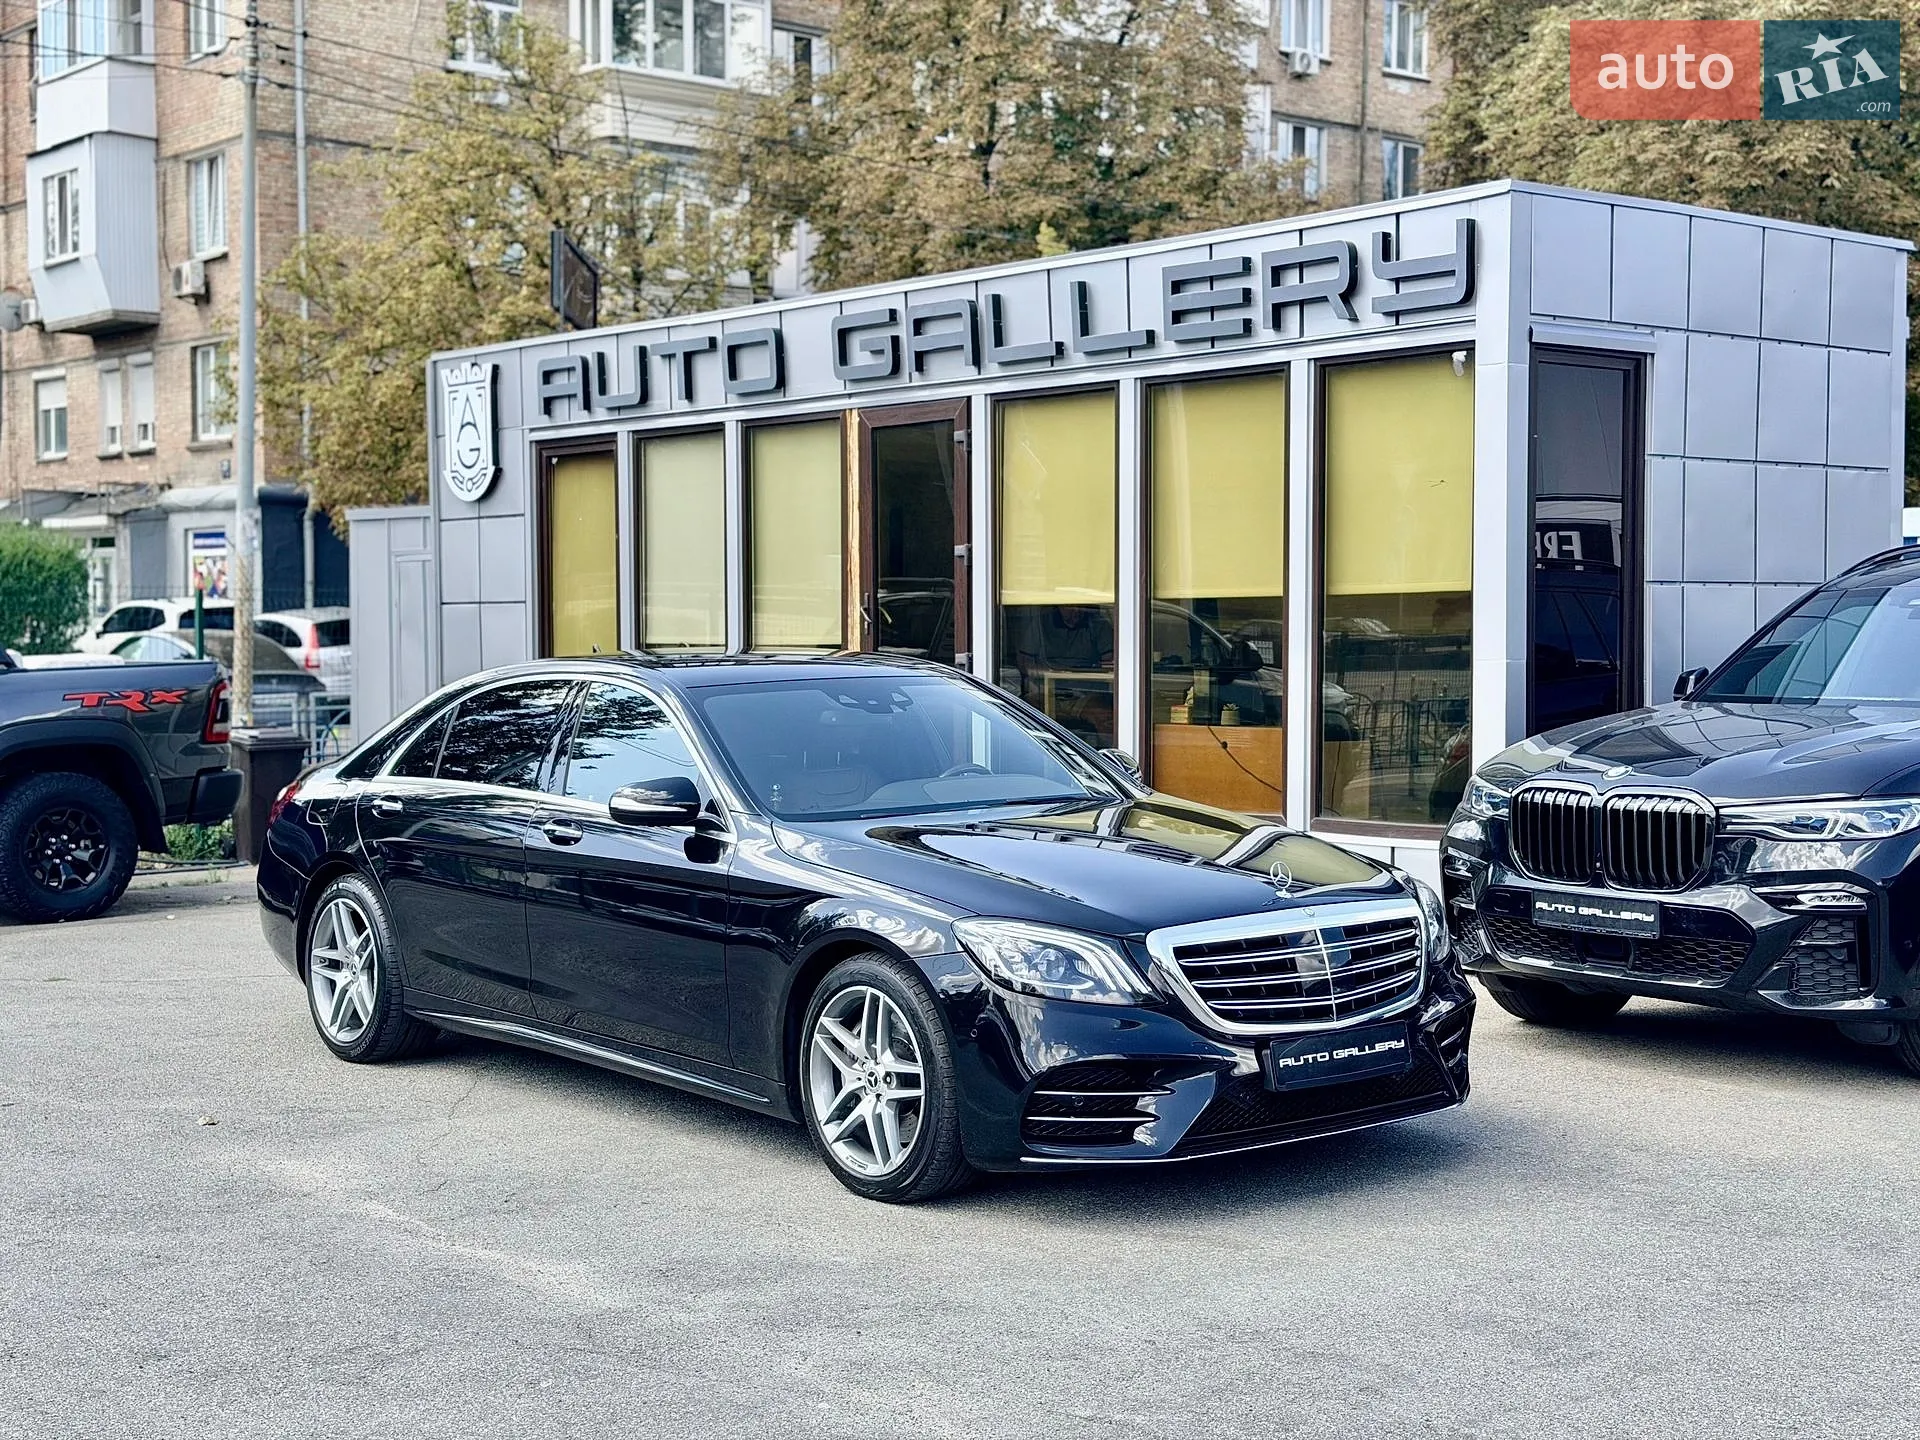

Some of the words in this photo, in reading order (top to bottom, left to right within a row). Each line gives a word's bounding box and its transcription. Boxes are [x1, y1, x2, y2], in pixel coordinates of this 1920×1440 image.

[537, 327, 784, 416] AUTO
[831, 218, 1475, 381] GALLERY
[62, 688, 190, 713] TRX
[1535, 901, 1576, 914] AUTO
[1578, 906, 1655, 922] GALLERY
[1279, 1051, 1330, 1068] AUTO
[1333, 1039, 1405, 1060] GALLERY
